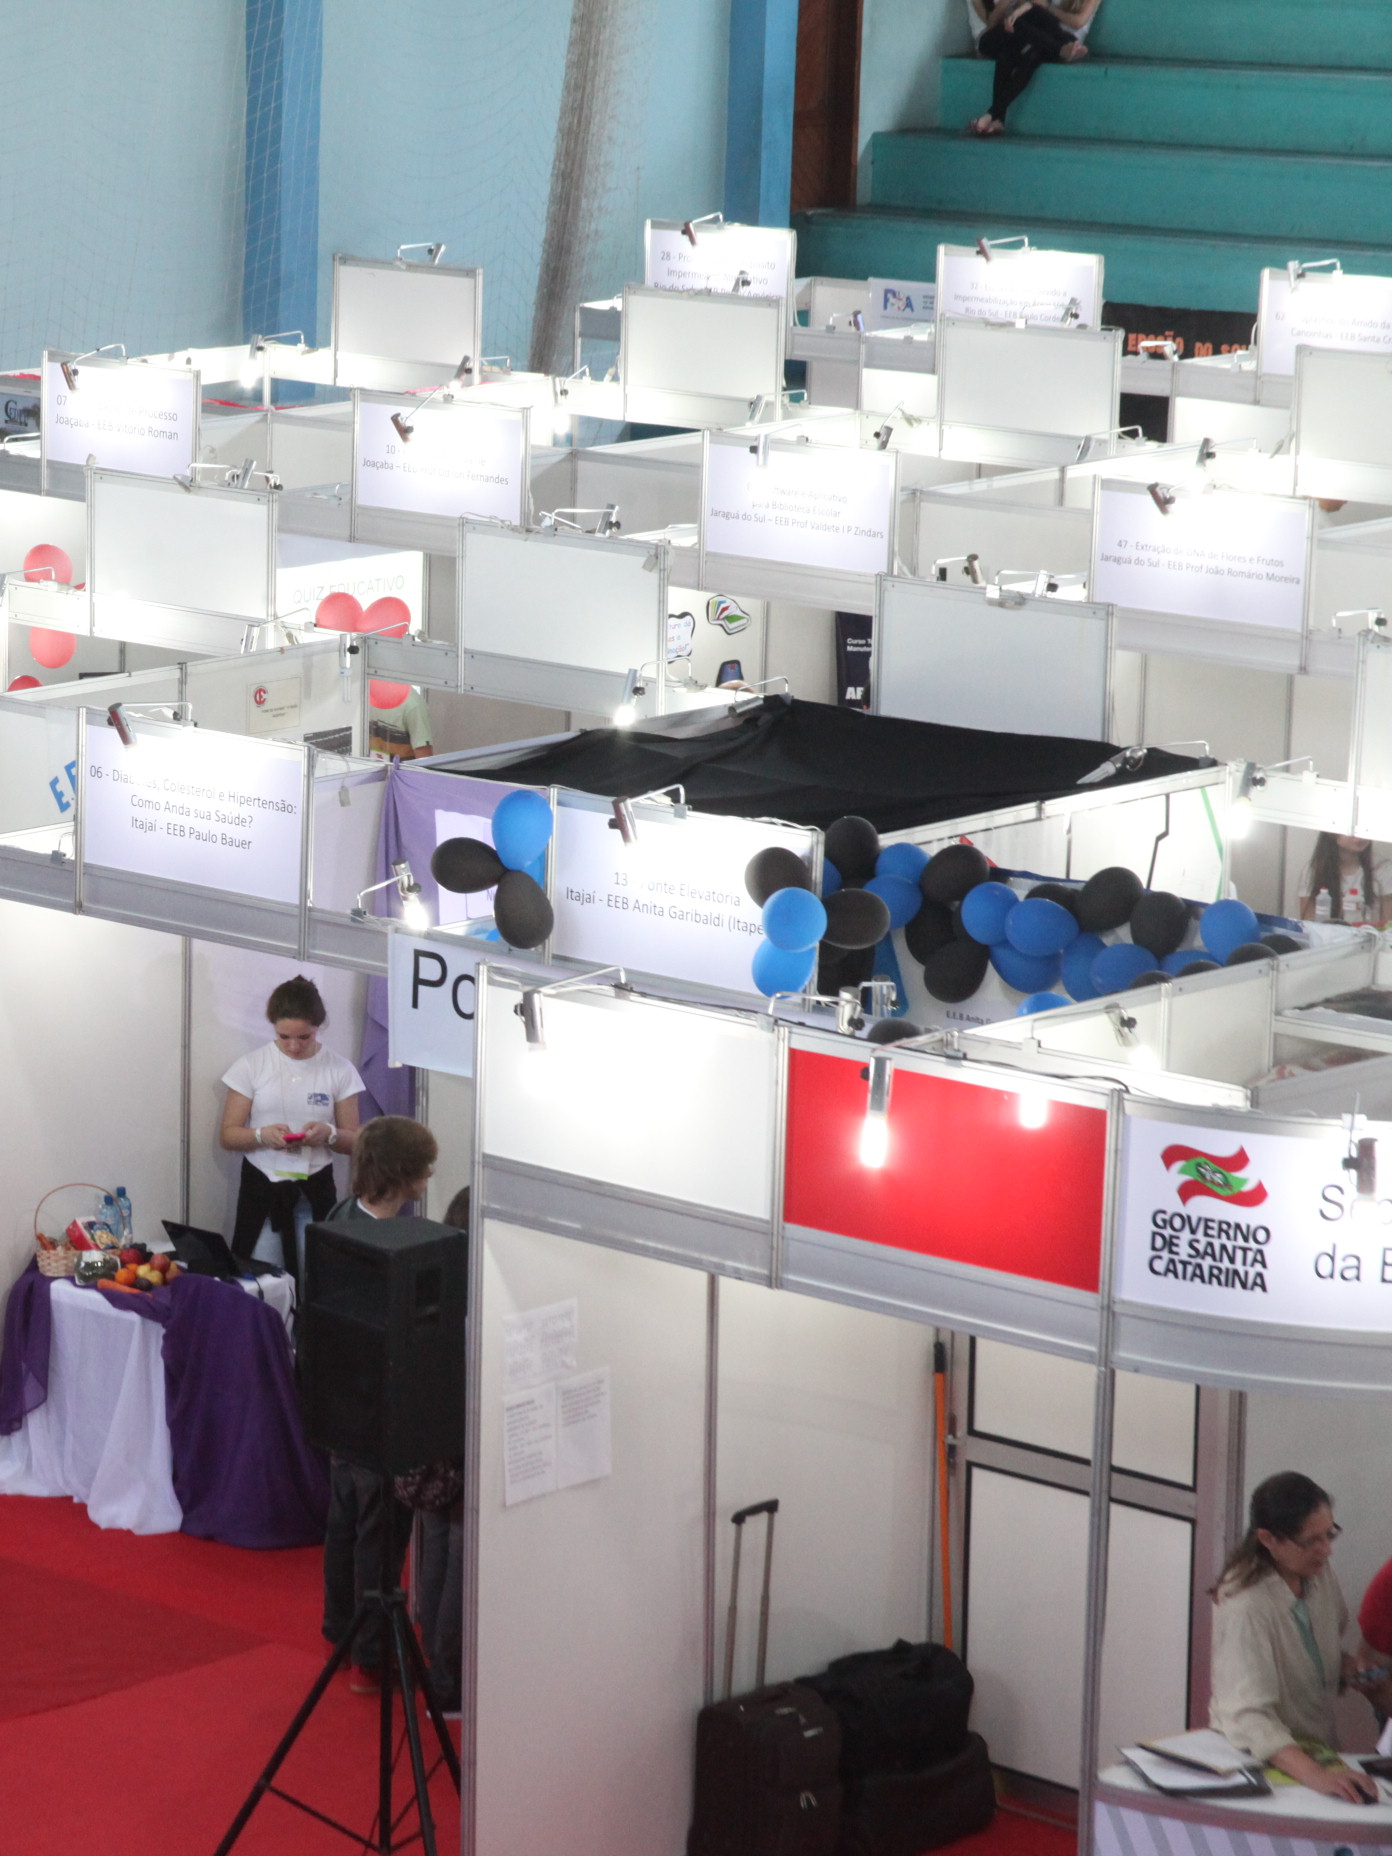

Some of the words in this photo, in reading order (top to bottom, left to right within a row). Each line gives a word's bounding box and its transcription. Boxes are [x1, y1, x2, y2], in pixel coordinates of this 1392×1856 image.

[661, 250, 671, 260] 28
[56, 394, 67, 406] 07
[55, 413, 90, 429] Joaçaba
[148, 426, 179, 440] Roman
[386, 443, 396, 455] 10
[363, 457, 394, 470] Joaçaba
[467, 470, 509, 486] Fernandes
[710, 507, 740, 521] Jaraguá
[741, 512, 752, 522] do
[753, 513, 766, 524] Sul
[774, 516, 790, 527] EEB
[791, 517, 808, 529] Prof
[854, 526, 885, 540] Zindars
[813, 507, 842, 519] Escolar
[1100, 552, 1132, 566] Jaraguá
[1134, 557, 1145, 567] do
[1146, 558, 1160, 568] Sul
[1167, 560, 1184, 571] EEB
[1185, 563, 1203, 574] Prof
[1205, 565, 1225, 577] João
[1227, 566, 1264, 581] Romário
[1265, 571, 1301, 586] Moreira
[1117, 540, 1128, 550] 47
[1135, 541, 1172, 556] Extração
[1257, 555, 1285, 568] Frutos
[293, 585, 324, 604] QUIZ
[89, 765, 103, 779] 06
[163, 778, 216, 800] Colesterol
[218, 790, 225, 801] e
[227, 789, 298, 815] Hipertensão:
[130, 793, 161, 812] Como
[163, 801, 191, 818] Anda
[193, 807, 212, 822] sua
[214, 809, 254, 830] Saúde?
[131, 815, 157, 834] Itajaí
[166, 822, 187, 838] EEB
[188, 826, 218, 845] Paulo
[220, 832, 253, 851] Bauer
[614, 871, 628, 888] 13
[565, 886, 597, 907] Itajaí
[607, 893, 629, 911] EEB
[632, 899, 665, 918] Anita
[667, 905, 725, 929] Garibaldi
[727, 914, 765, 937] (Itape
[411, 948, 475, 1022] Po
[1151, 1208, 1272, 1246] GOVERNO
[1150, 1231, 1181, 1256] DE
[1187, 1238, 1269, 1271] SANTA
[1313, 1242, 1362, 1283] da
[1148, 1254, 1269, 1294] CATARINA
